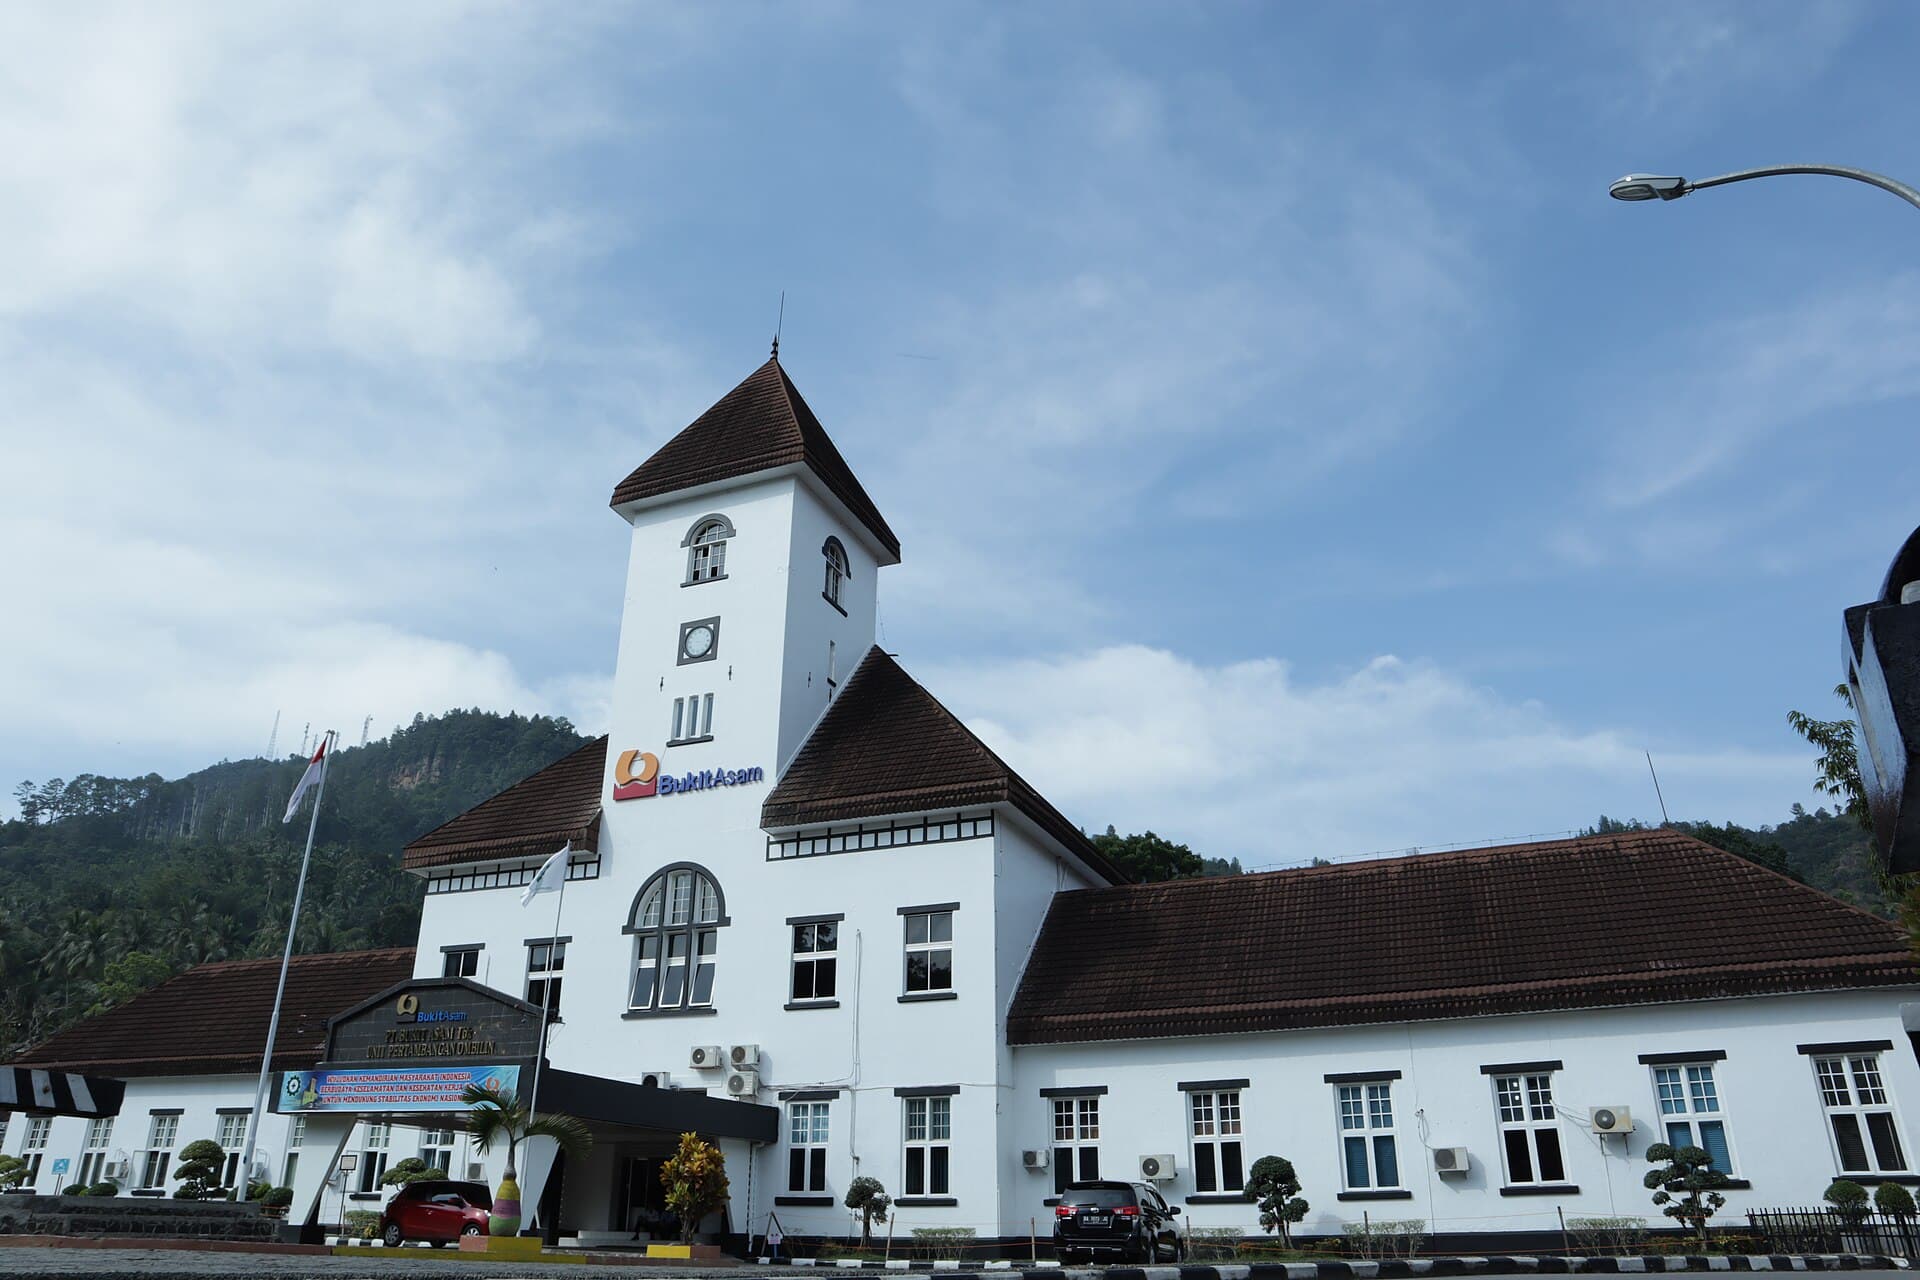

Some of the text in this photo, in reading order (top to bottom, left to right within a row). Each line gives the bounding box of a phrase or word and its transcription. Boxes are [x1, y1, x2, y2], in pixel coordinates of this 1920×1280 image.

[387, 1042, 456, 1057] PERTAMBANGAN
[457, 1040, 495, 1056] OMBILIN
[399, 1073, 438, 1082] MASYARAKAT
[440, 1072, 471, 1081] INDONESIA
[353, 1084, 394, 1093] KESELAMATAN
[409, 1083, 442, 1092] KESEHATAN
[376, 1094, 411, 1103] STABILITAS
